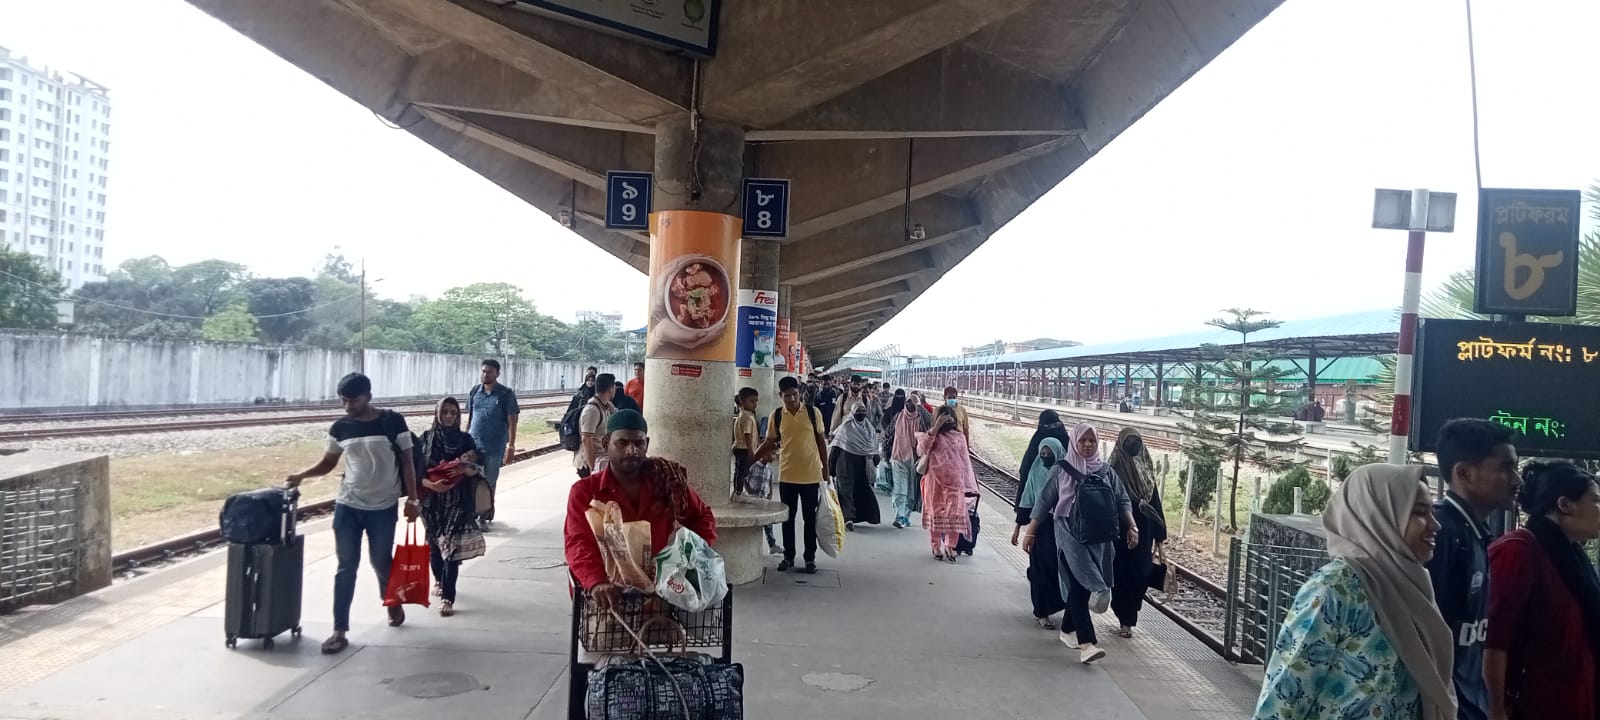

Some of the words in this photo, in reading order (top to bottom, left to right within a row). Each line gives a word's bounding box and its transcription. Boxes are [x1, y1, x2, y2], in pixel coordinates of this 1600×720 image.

[622, 181, 639, 200] ৯
[756, 189, 775, 206] ৮
[622, 203, 637, 222] 9
[757, 211, 772, 229] 8
[1499, 231, 1563, 300] ৮
[1457, 335, 1537, 361] প্লাটফর্ম
[1581, 346, 1599, 363] ৮
